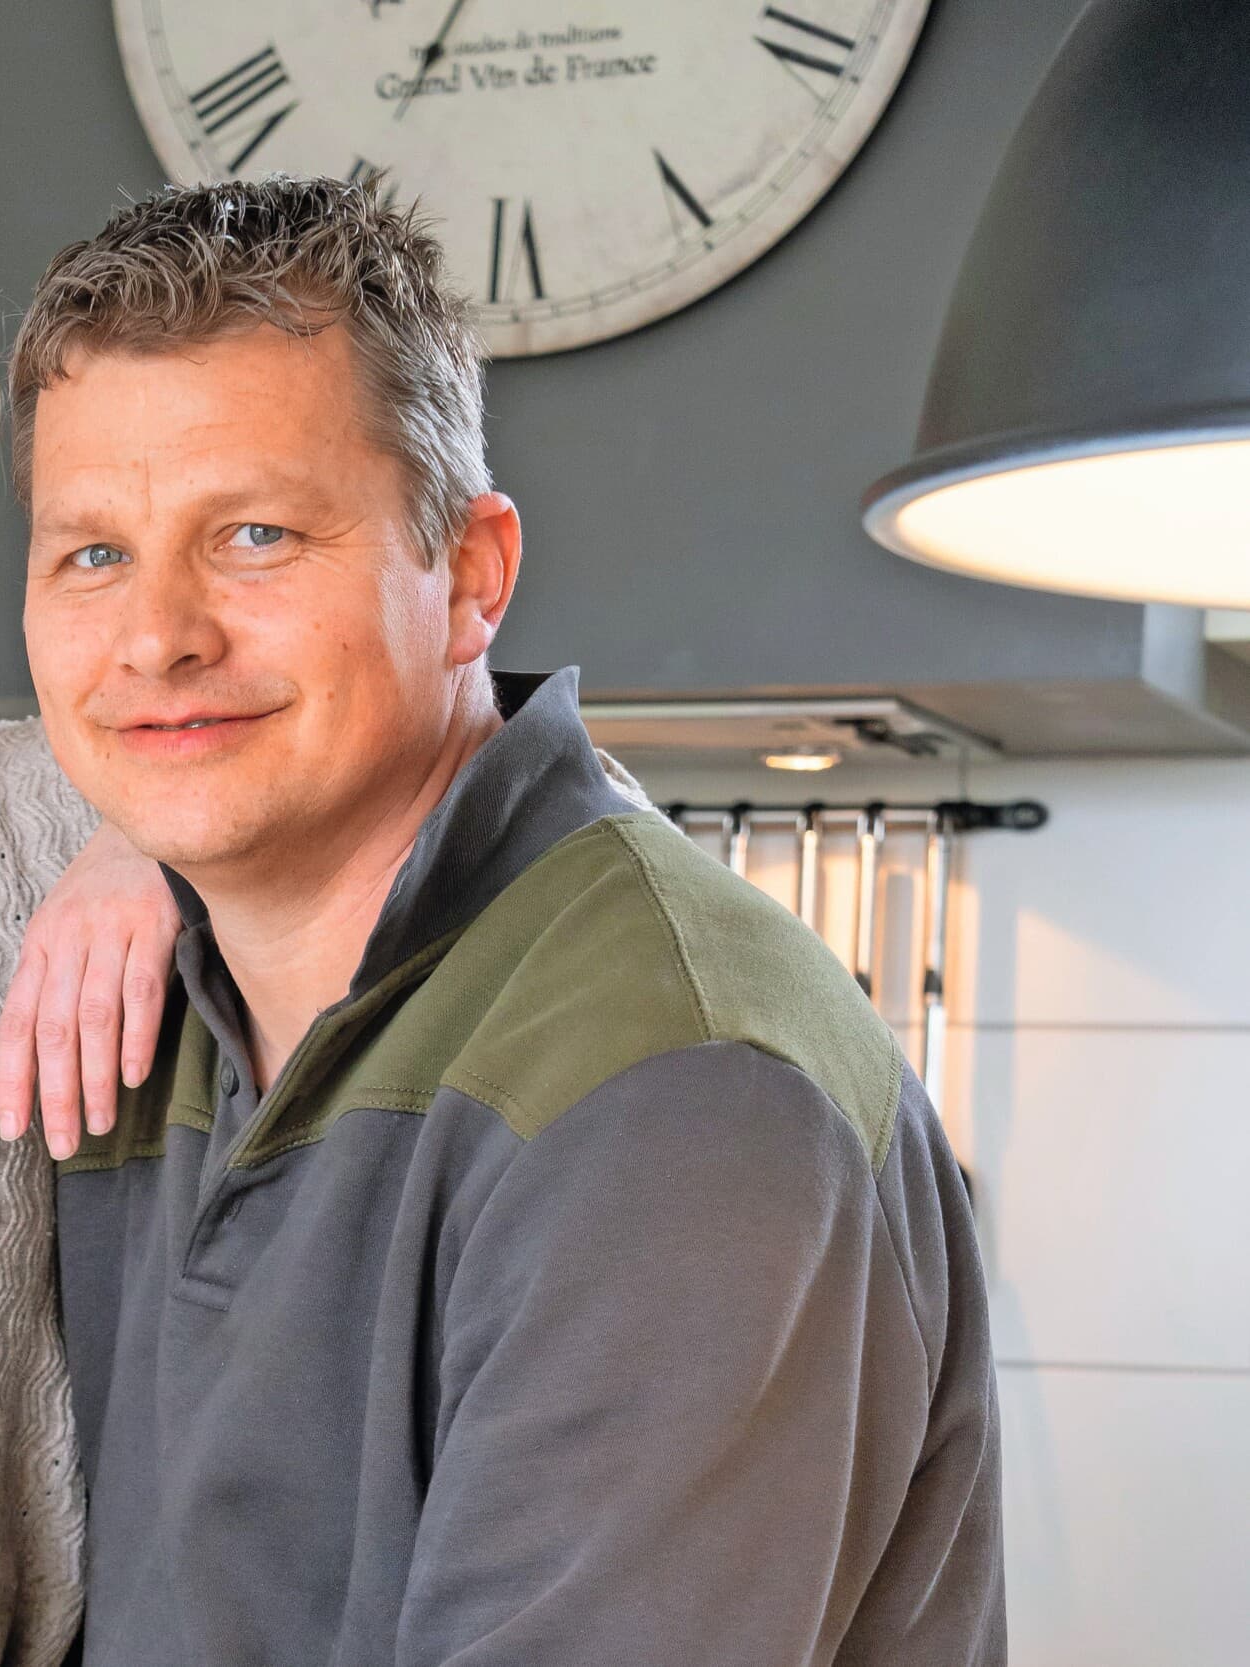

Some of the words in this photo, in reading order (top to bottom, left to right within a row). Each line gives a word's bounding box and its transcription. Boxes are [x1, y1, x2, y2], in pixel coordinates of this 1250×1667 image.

[469, 62, 518, 90] Vin
[524, 54, 559, 86] de
[565, 53, 658, 82] France
